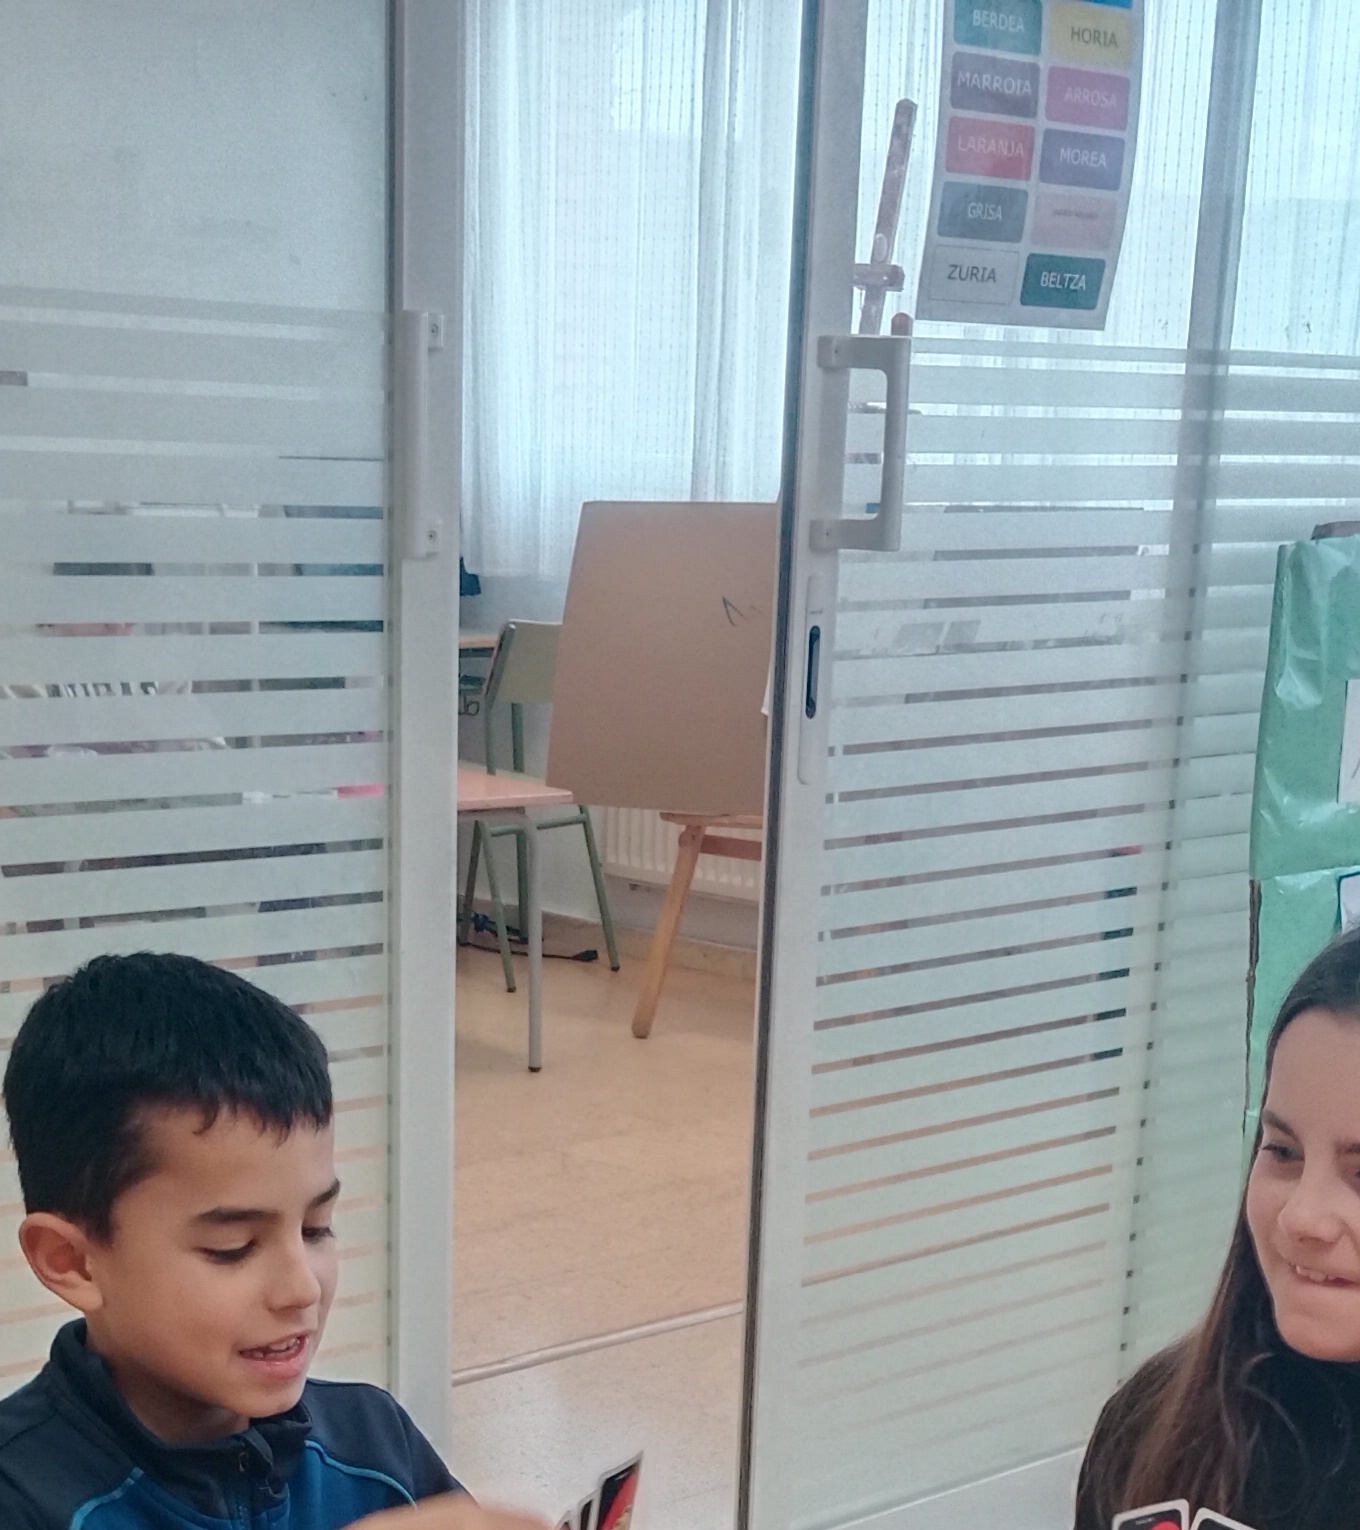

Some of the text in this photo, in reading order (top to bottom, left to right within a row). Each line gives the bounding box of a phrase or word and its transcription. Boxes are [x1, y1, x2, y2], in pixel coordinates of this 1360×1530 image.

[972, 9, 1025, 33] BERDEA
[1071, 26, 1118, 49] HORIA
[957, 70, 1032, 96] MARROIA
[1064, 87, 1117, 108] ARROSA
[958, 135, 1025, 158] LARANJA
[1059, 147, 1107, 169] MOREA
[967, 202, 1003, 221] GRISA
[946, 264, 997, 283] ZURIA
[1040, 272, 1086, 290] BELTZA
